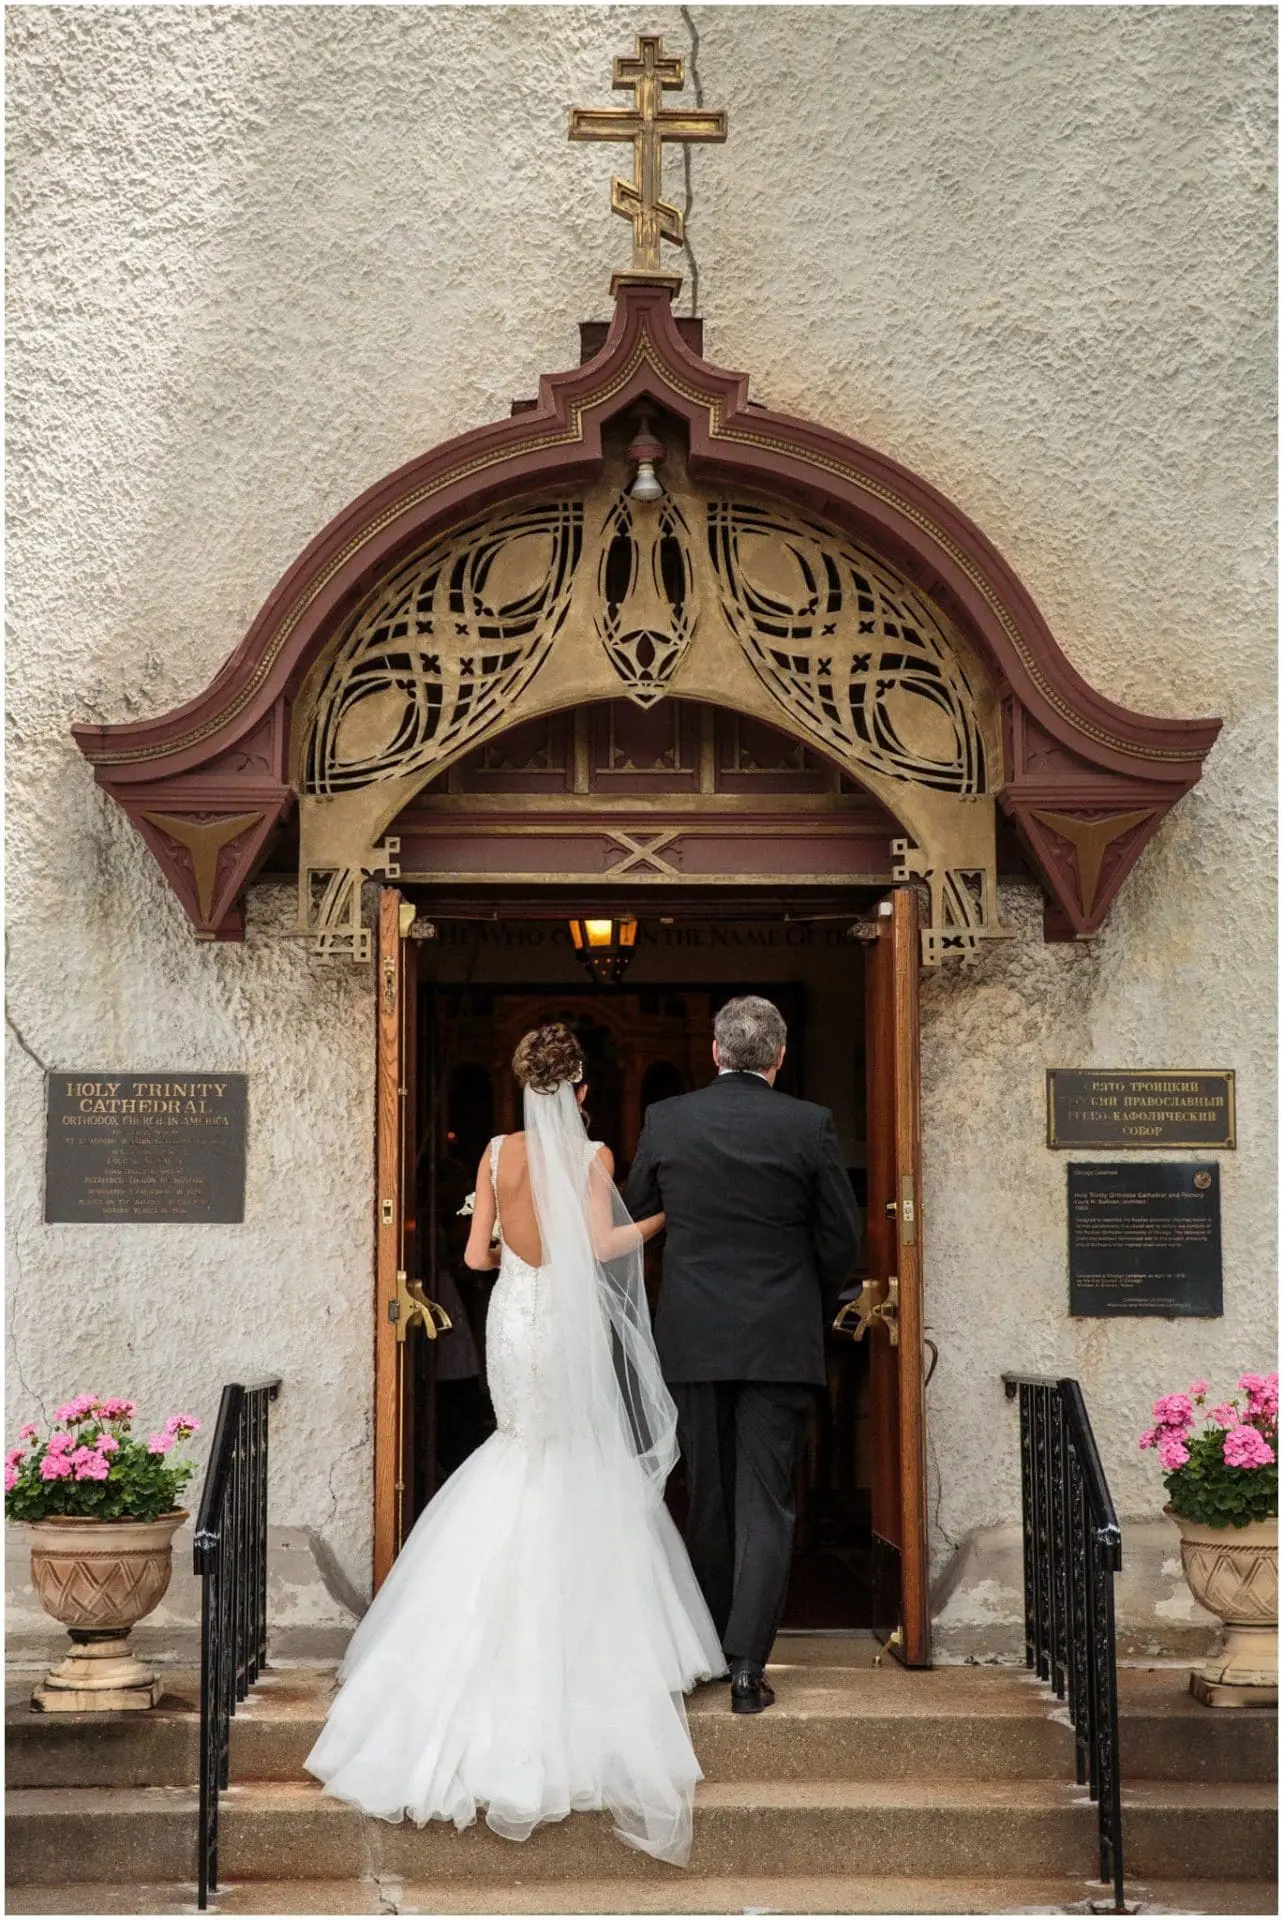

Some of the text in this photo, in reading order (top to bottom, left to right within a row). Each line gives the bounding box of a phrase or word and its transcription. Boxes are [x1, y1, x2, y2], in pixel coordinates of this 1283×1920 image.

[662, 927, 703, 947] THE
[708, 922, 780, 947] NAME
[65, 1082, 228, 1097] HOLY TRINITY
[79, 1099, 213, 1113] CATHEDRAL
[62, 1115, 119, 1126] ORTHODOX
[167, 1115, 179, 1126] IN
